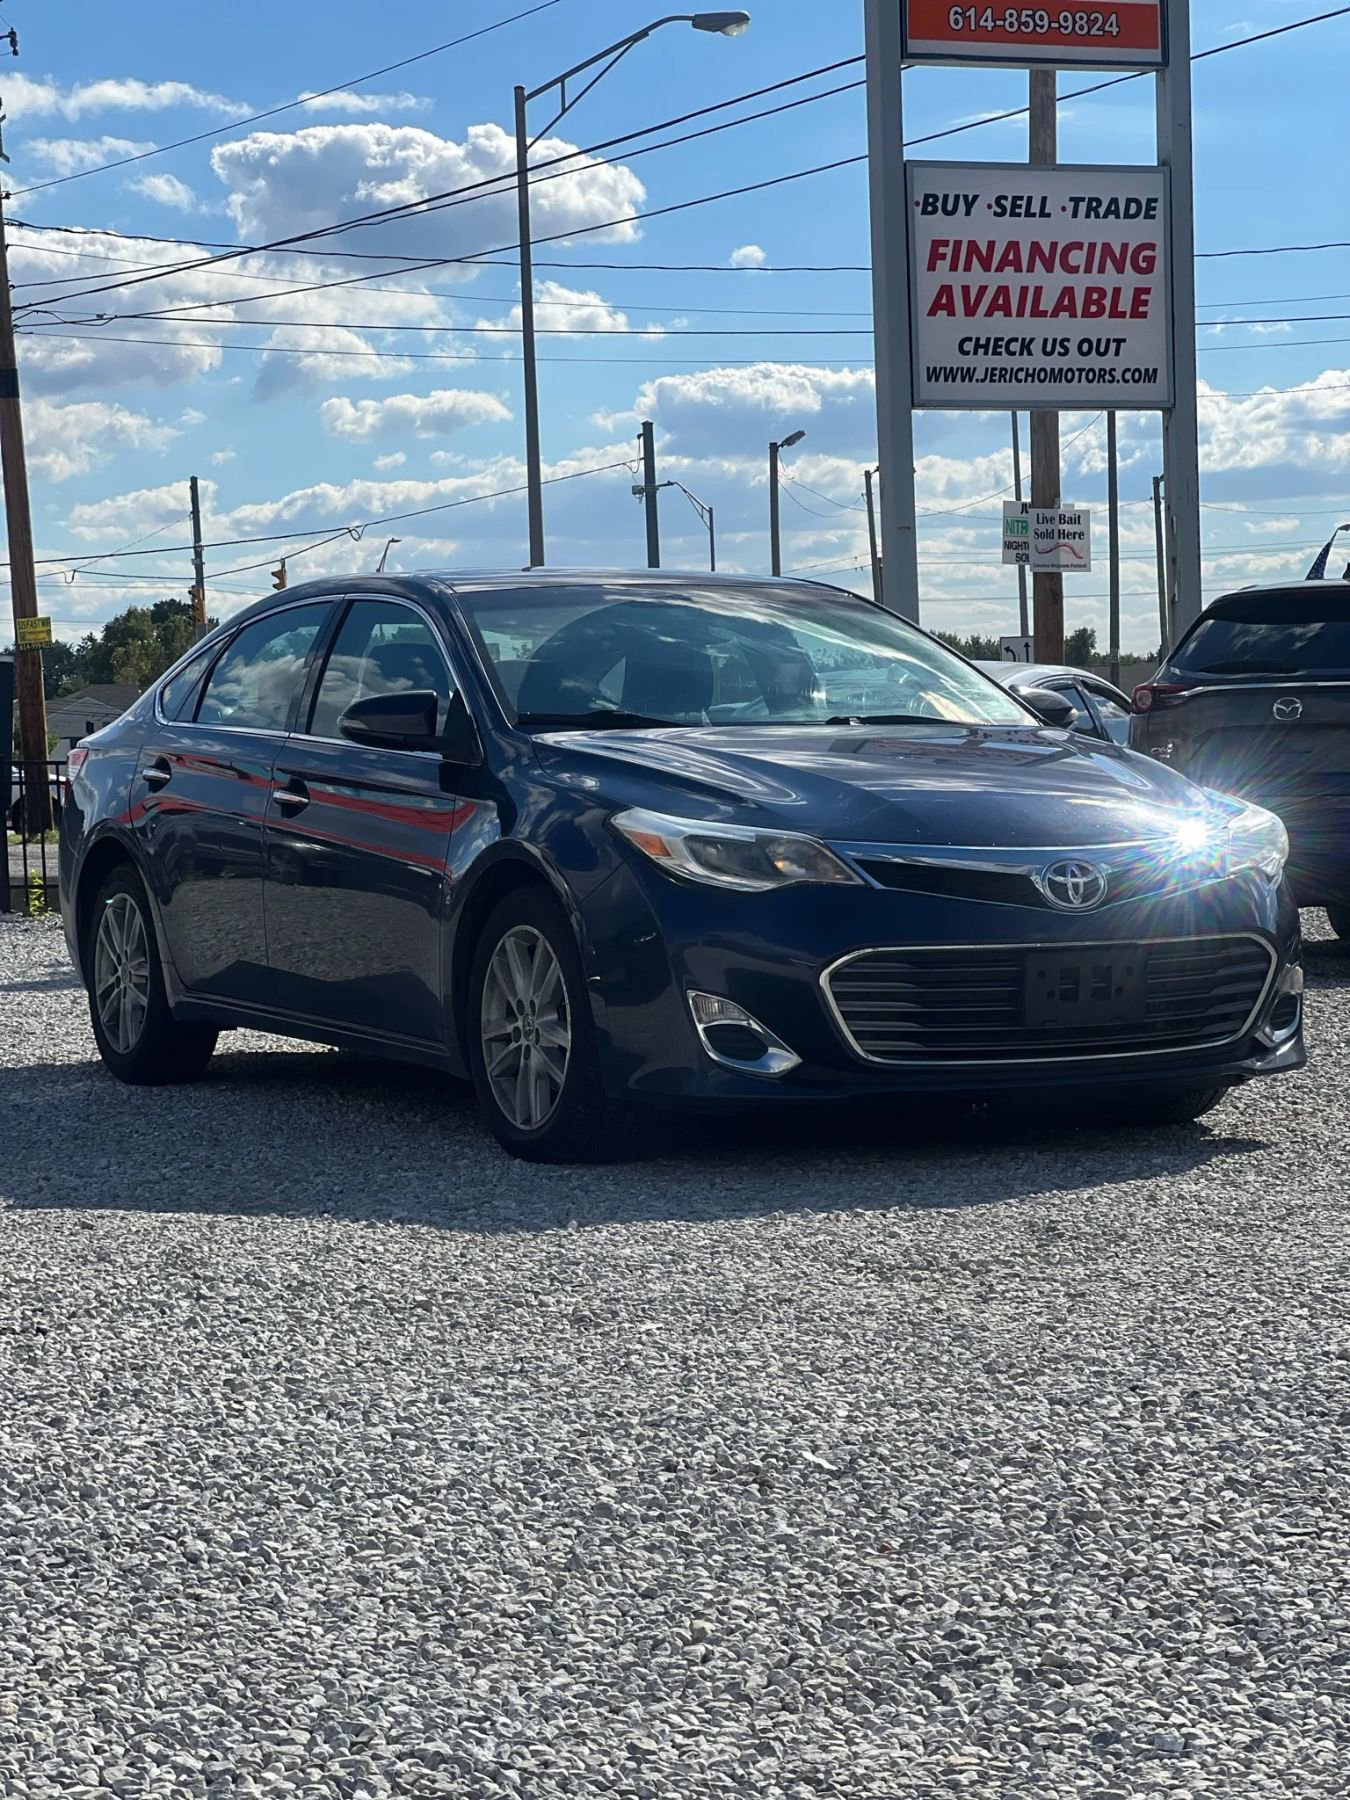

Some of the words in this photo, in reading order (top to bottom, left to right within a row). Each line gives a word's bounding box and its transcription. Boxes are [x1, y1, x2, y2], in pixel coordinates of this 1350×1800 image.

[949, 6, 1120, 37] 614-859-9824
[926, 239, 1157, 275] FINANCING
[926, 285, 1152, 319] AVAILABLE
[957, 336, 1035, 357] CHECK
[1041, 337, 1070, 357] US
[1077, 338, 1126, 357] OUT
[926, 366, 1158, 384] WWW.JERICHOMOTORS.COM
[1005, 518, 1029, 536] NITR
[1036, 513, 1056, 525] Live
[1058, 513, 1082, 525] Bait
[1033, 528, 1055, 540] Sold
[1057, 528, 1085, 540] Here
[1004, 540, 1030, 551] NIGHT
